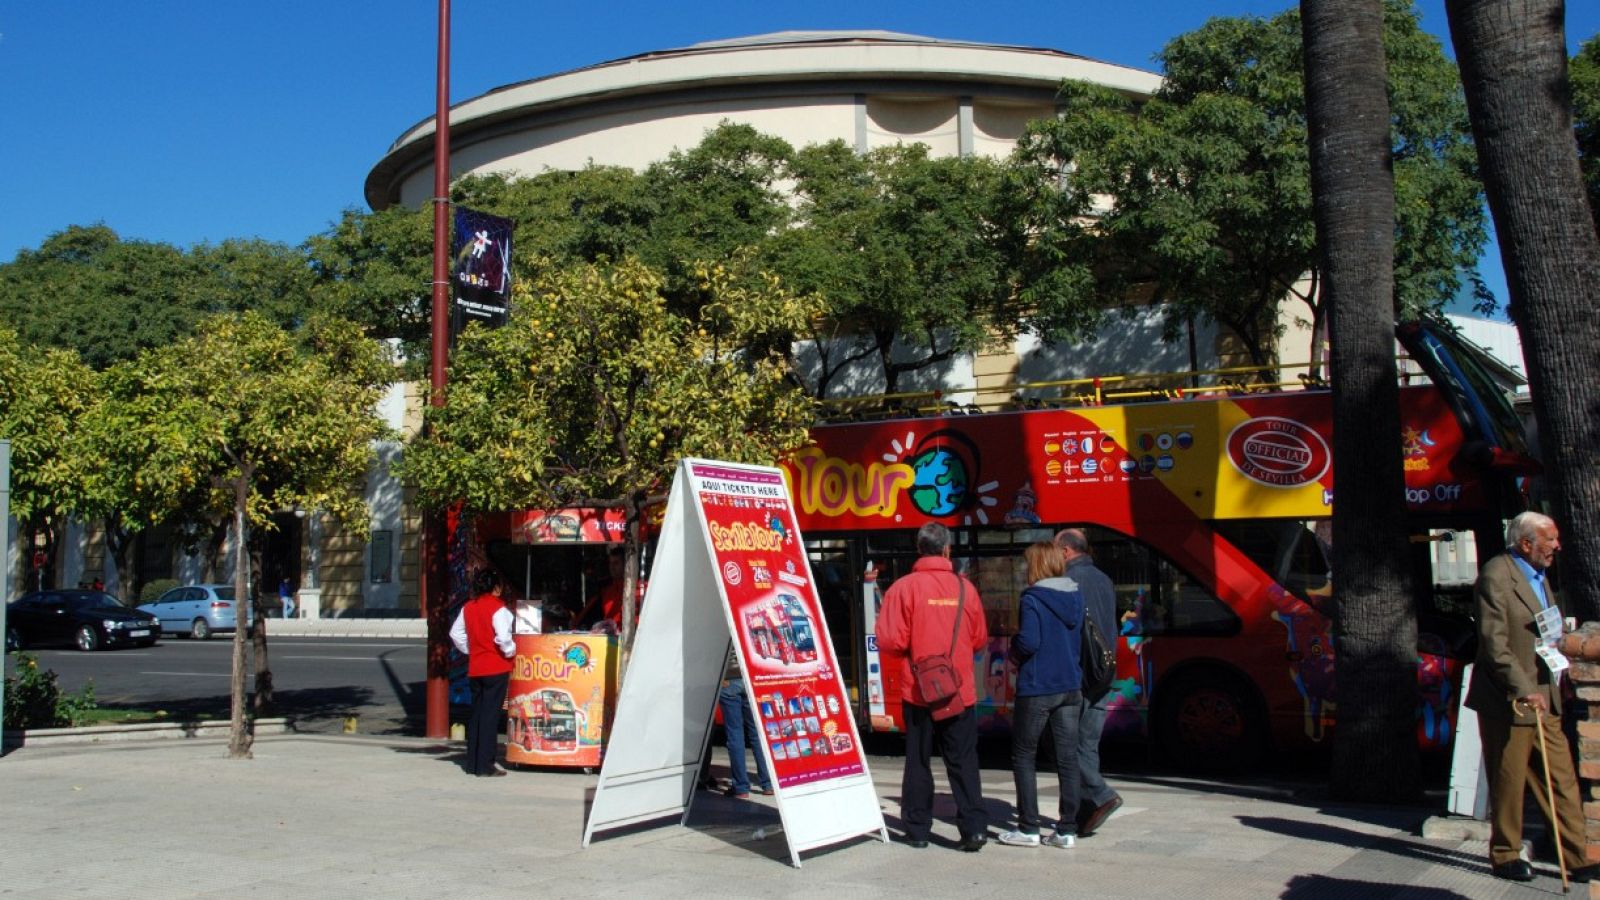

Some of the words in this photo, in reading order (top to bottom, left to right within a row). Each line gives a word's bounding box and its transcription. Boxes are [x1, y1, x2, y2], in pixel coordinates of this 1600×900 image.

[1265, 421, 1298, 435] TOUR
[1246, 442, 1308, 463] OFFICIAL
[780, 447, 916, 517] Tour
[1242, 461, 1257, 474] DE
[1258, 471, 1307, 484] SEVILLA
[702, 480, 721, 491] AQUI
[722, 483, 757, 495] TICKETS
[758, 487, 779, 496] HERE
[1435, 484, 1461, 501] Off
[594, 520, 626, 531] TICKE
[511, 654, 580, 682] llaTour
